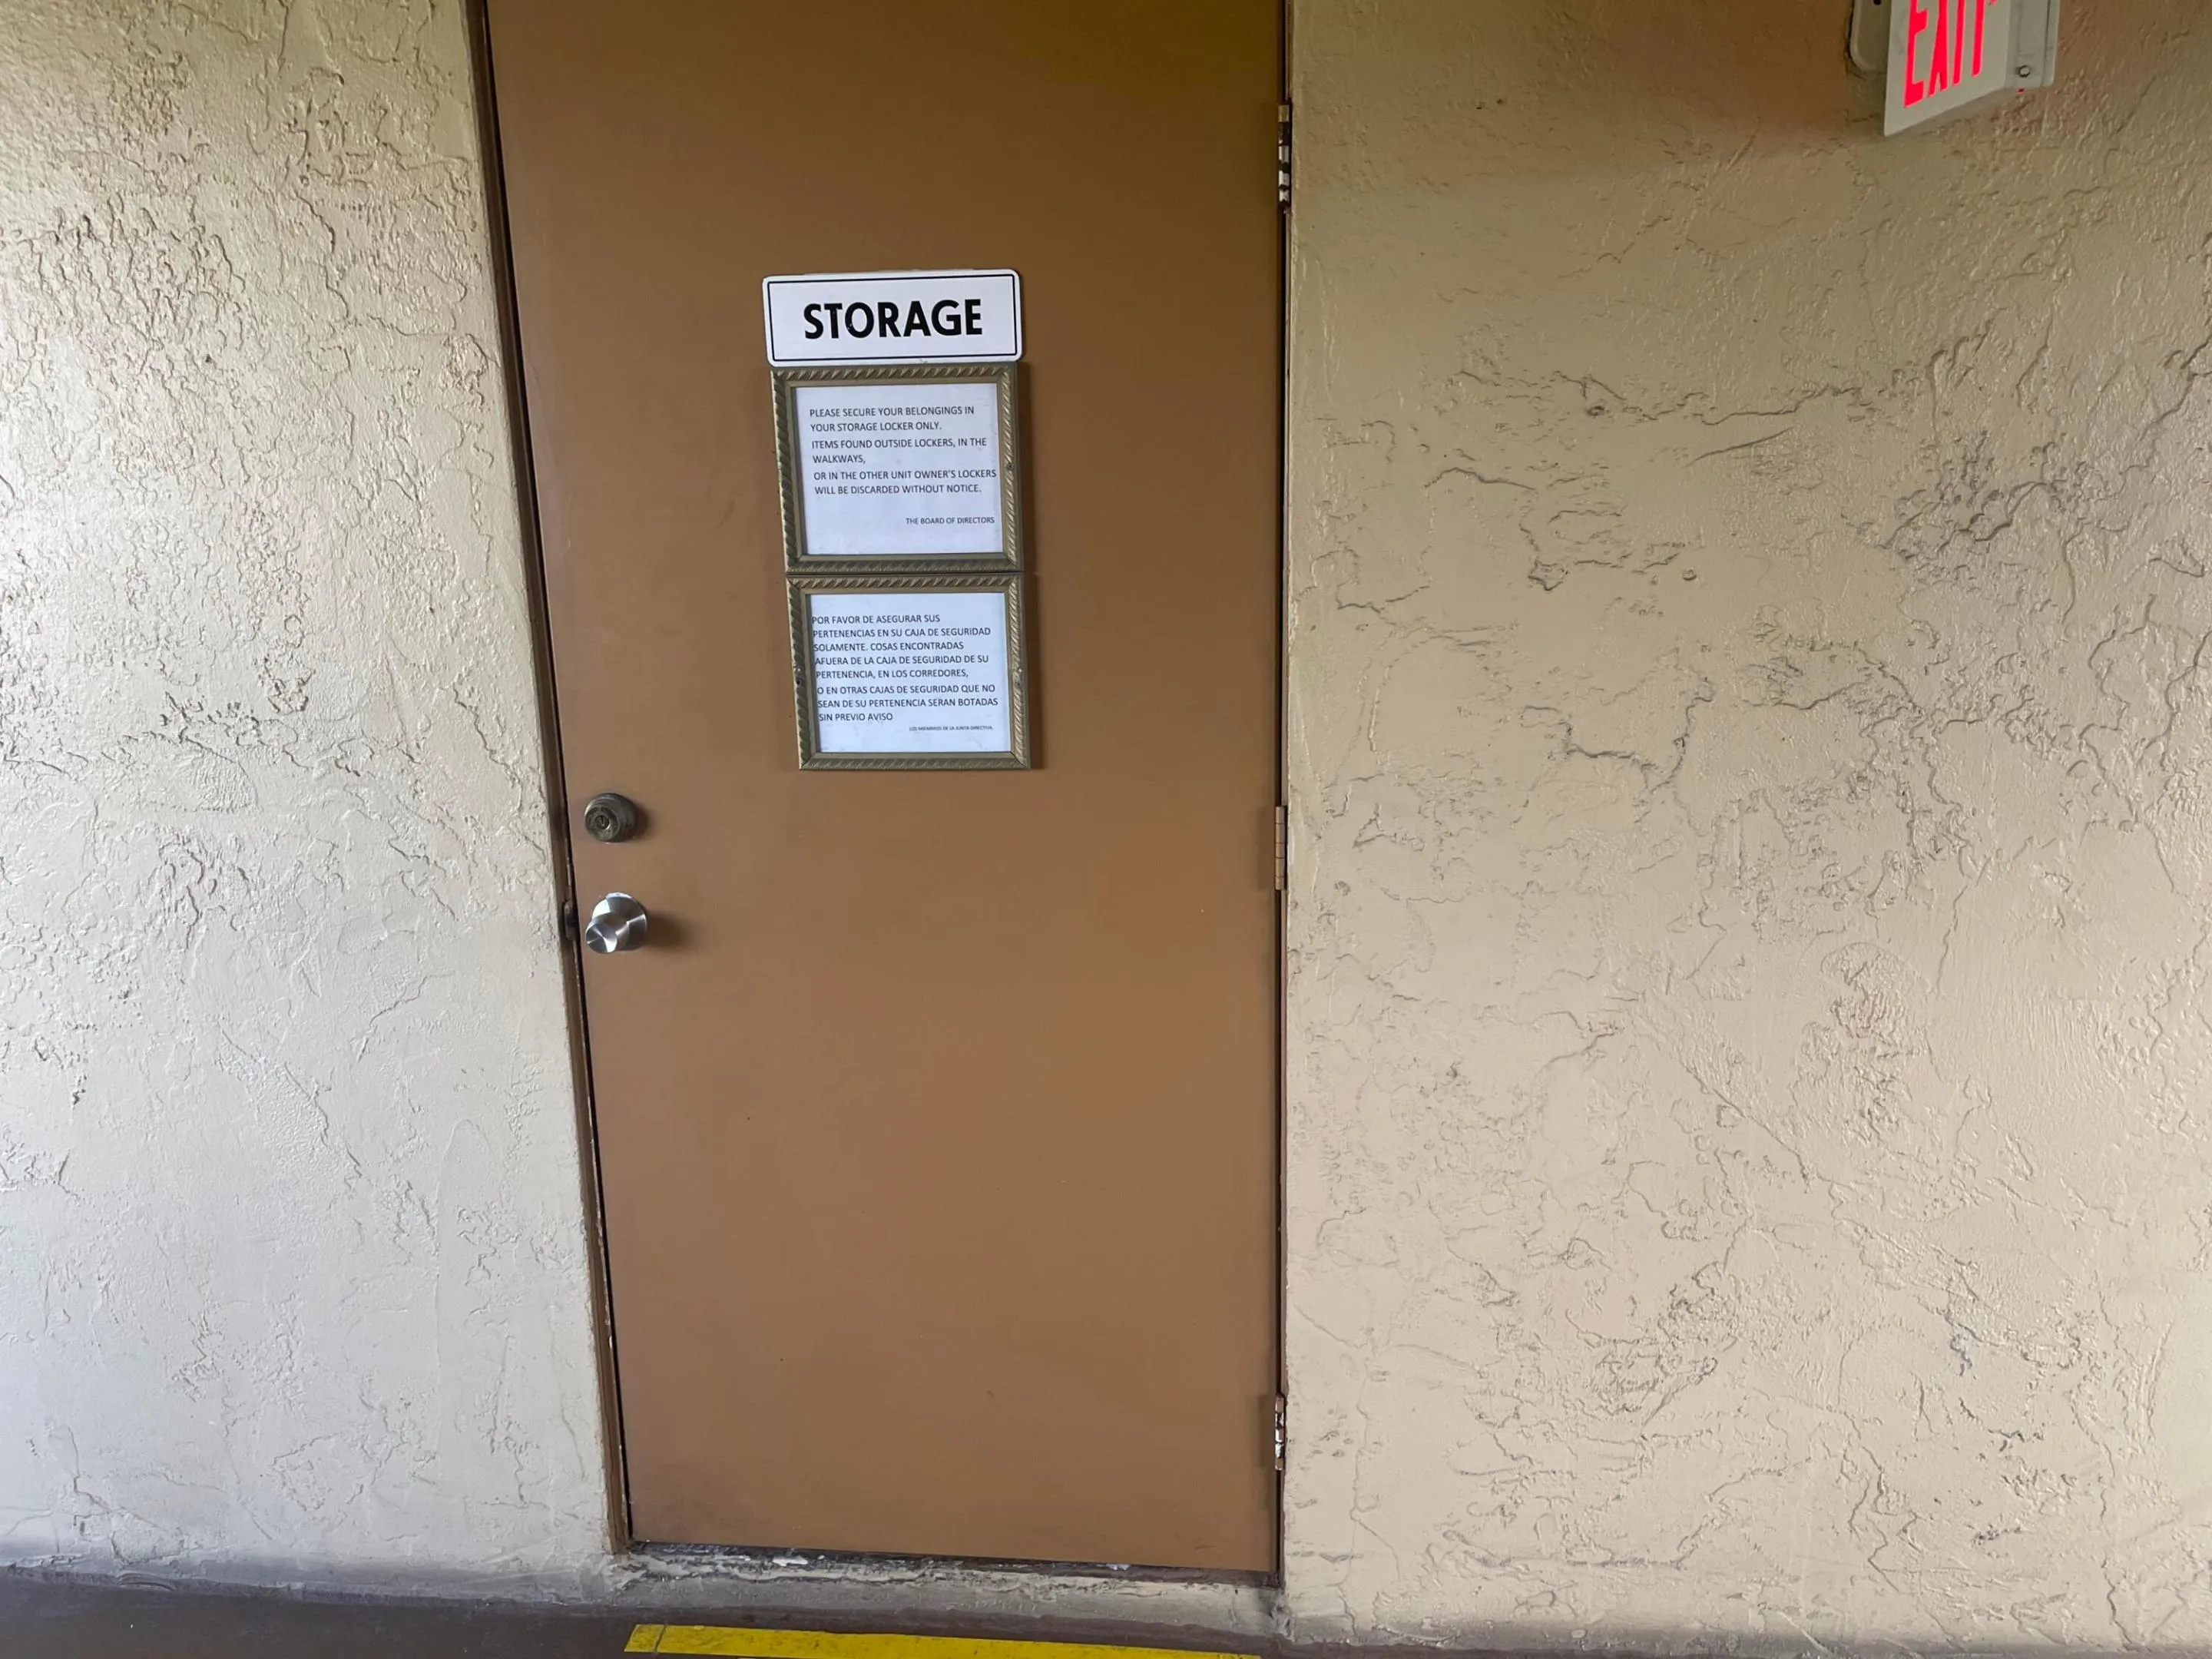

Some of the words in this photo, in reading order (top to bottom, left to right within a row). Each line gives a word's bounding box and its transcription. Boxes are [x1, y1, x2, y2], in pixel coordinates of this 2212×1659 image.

[803, 299, 983, 339] STORAGE
[810, 408, 840, 418] PLEASE
[843, 408, 876, 417] SECURE
[878, 407, 903, 416] YOUR
[906, 407, 962, 416] BELONGINGS
[965, 406, 974, 414] IN
[837, 422, 877, 432] STORAGE
[880, 422, 913, 431] LOCKER
[916, 422, 942, 431] ONLY.
[812, 440, 839, 449] ITEMS
[841, 439, 873, 449] FOUND
[875, 439, 912, 448] OUTSIDE
[915, 439, 955, 448] LOCKERS,
[958, 439, 968, 447] IN
[969, 438, 987, 446] THE
[813, 455, 866, 465] WALKWAYS,
[814, 472, 826, 481] OR
[829, 472, 838, 480] IN
[840, 471, 857, 480] THE
[859, 471, 889, 479] OTHER
[891, 470, 912, 479] UNIT
[914, 470, 956, 478] OWNER'S
[959, 469, 997, 478] LOCKERS
[815, 486, 836, 495] WILL
[838, 486, 849, 495] BE
[851, 485, 900, 494] DISCARDED
[902, 485, 944, 494] WITHOUT
[946, 484, 982, 493] NOTICE.
[812, 616, 830, 624] POR
[833, 616, 861, 624] FAVOR
[863, 615, 874, 624] DE
[876, 614, 922, 624] ASEGURAR
[924, 614, 940, 623] SUS
[813, 629, 876, 638] PERTENENCIAS
[905, 628, 926, 637] CAJA
[941, 628, 991, 636] SEGURIDAD
[870, 643, 898, 651] COSAS
[900, 641, 964, 651] ENCONTRADAS
[815, 657, 849, 665] AFUERA
[851, 657, 862, 665] DE
[864, 657, 874, 665] LA
[876, 656, 897, 664] CAJA
[899, 656, 910, 664] DE
[912, 655, 962, 664] SEGURIDAD
[977, 654, 988, 663] SU
[816, 671, 876, 680] PERTENENCIA,
[892, 670, 907, 678] LOS
[909, 669, 969, 678] CORREDORES,
[817, 687, 824, 695] O
[826, 687, 837, 695] EN
[839, 686, 867, 694] OTRAS
[869, 686, 895, 694] CAJAS
[909, 685, 959, 694] SEGURIDAD
[962, 684, 980, 694] QUE
[982, 684, 995, 693] NO
[817, 700, 840, 708] SEAN
[842, 699, 853, 707] DE
[856, 699, 866, 707] SU
[869, 699, 926, 707] PERTENENCIA
[929, 698, 955, 707] SERAN
[958, 697, 998, 707] BOTADAS
[819, 714, 833, 722] SIN
[835, 713, 866, 721] PREVIO
[868, 713, 893, 721] AVISO
